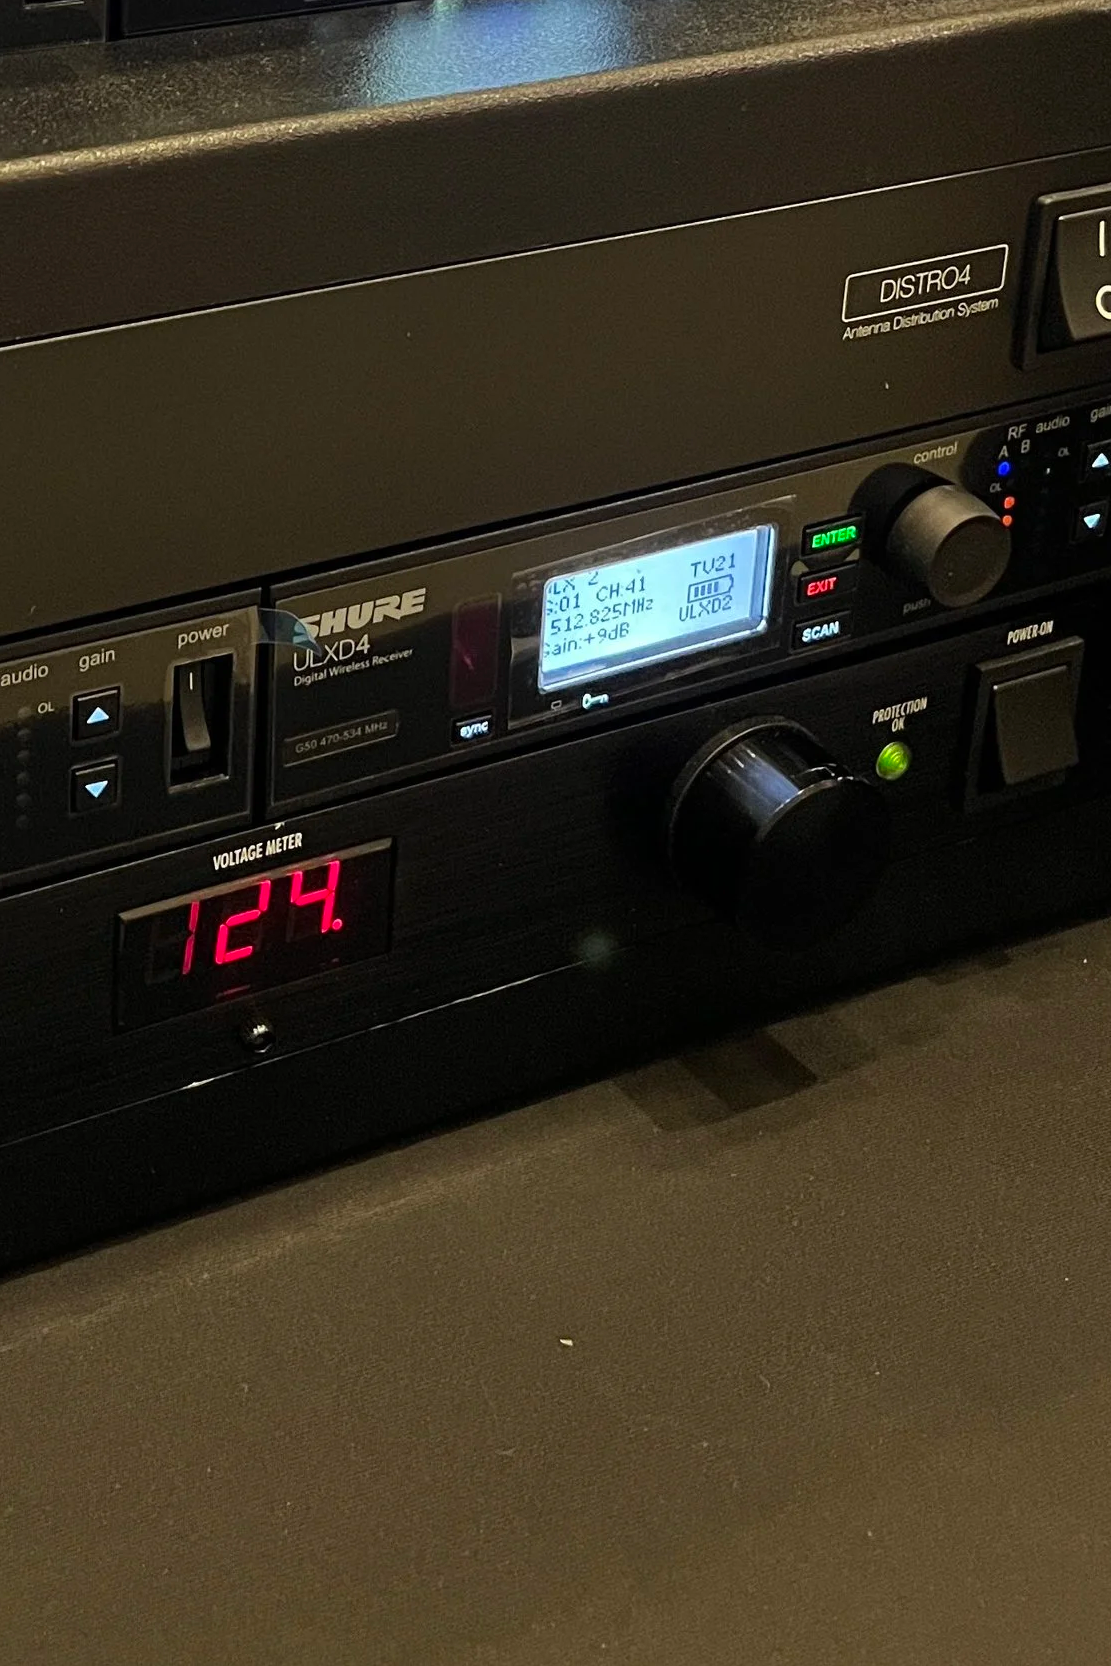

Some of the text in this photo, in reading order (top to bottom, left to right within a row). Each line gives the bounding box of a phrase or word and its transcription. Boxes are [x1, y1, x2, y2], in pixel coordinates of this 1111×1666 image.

[879, 264, 971, 304] DISTRO4
[842, 296, 999, 341] Antenna Distribution System
[1007, 405, 1111, 441] RF audio gai
[913, 441, 959, 465] control
[811, 525, 857, 550] ENTER
[691, 553, 736, 578] TV21
[596, 576, 646, 602] CH:41
[807, 576, 837, 596] EXIT
[293, 588, 426, 642] SHURE
[551, 597, 654, 635] 512.825MHz
[678, 595, 733, 622] ULXD2
[802, 621, 840, 643] SCAN
[0, 664, 49, 688] audio
[78, 647, 116, 673] gain
[177, 622, 229, 649] power
[293, 634, 371, 672] ULXD4
[294, 648, 413, 686] Digital Wireless Receiver
[872, 696, 928, 725] PROTECTION
[891, 717, 905, 733] OK
[295, 720, 388, 754] G50 470-534 MHz
[459, 720, 489, 739] sync
[213, 832, 303, 871] VOLTAGE METER
